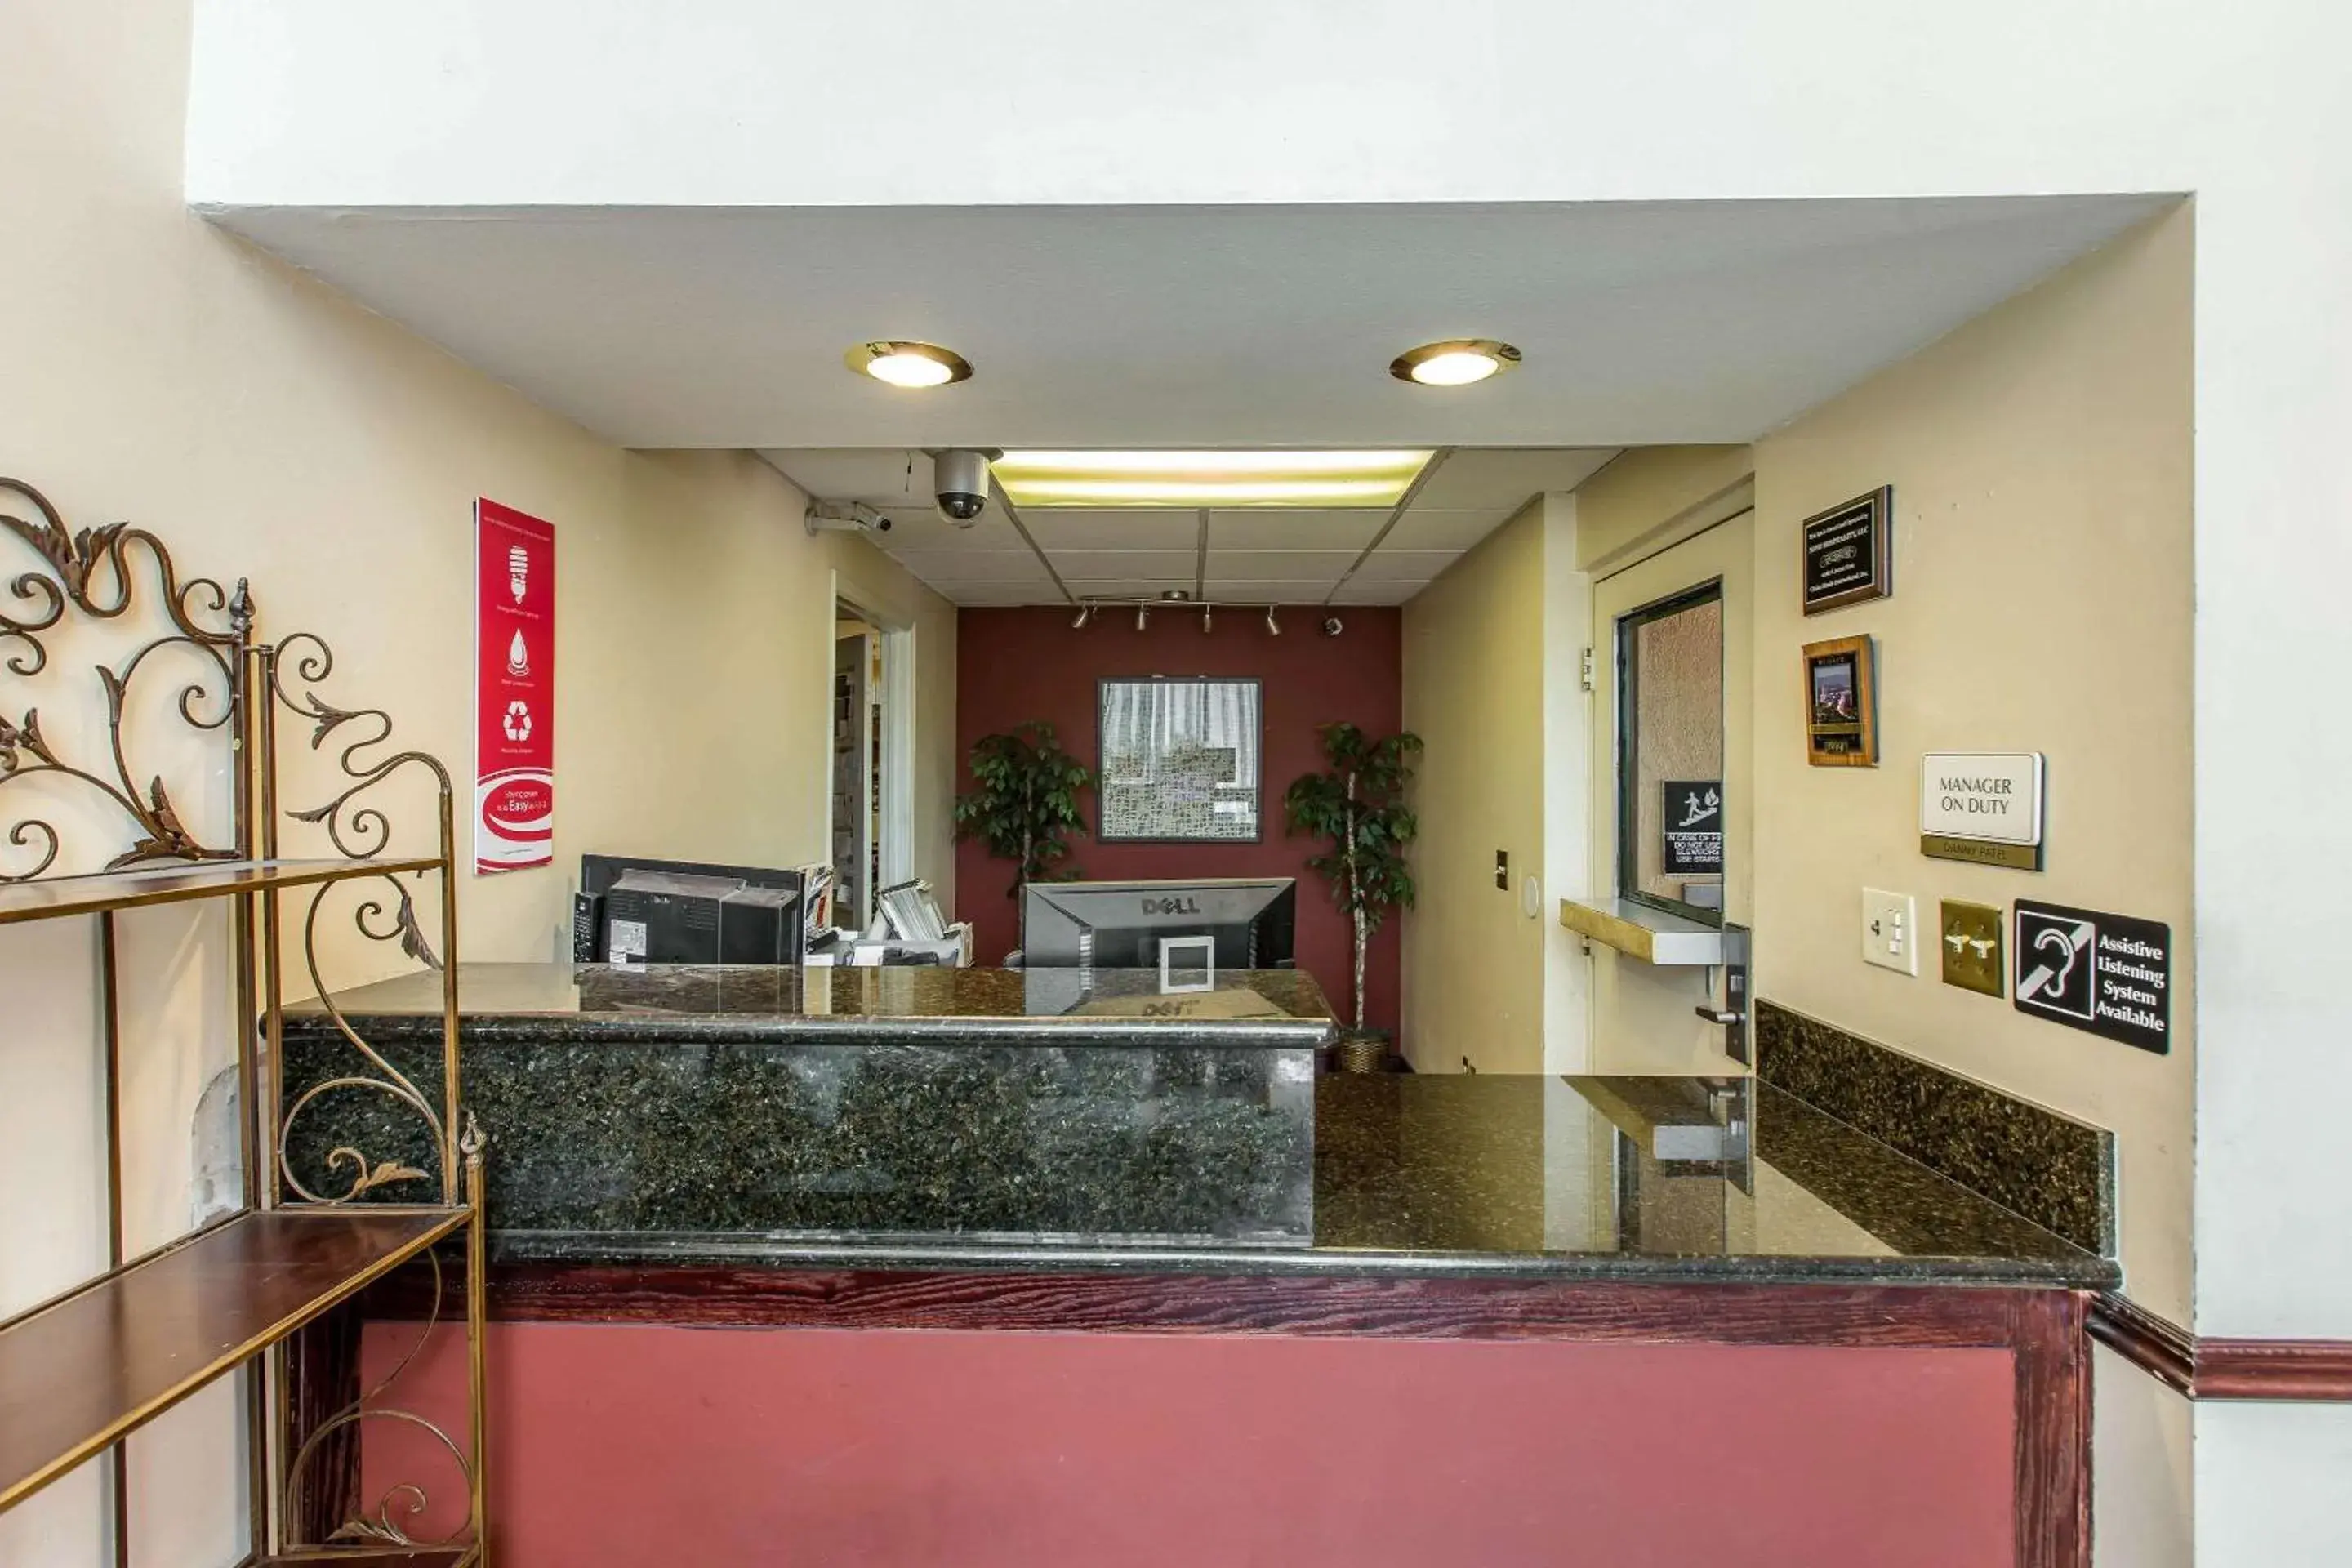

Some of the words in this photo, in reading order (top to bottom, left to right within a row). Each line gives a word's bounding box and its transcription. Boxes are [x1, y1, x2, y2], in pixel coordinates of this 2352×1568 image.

[1939, 777, 2012, 795] MANAGER
[509, 800, 529, 813] Easy
[1941, 795, 1964, 811] ON
[1968, 798, 2010, 814] DUTY
[1676, 856, 1693, 864] USE
[1142, 897, 1200, 915] DELL
[2098, 934, 2163, 960] Assistive
[2097, 956, 2165, 988] Listening
[2103, 979, 2157, 1005] System
[2096, 1000, 2165, 1031] Available
